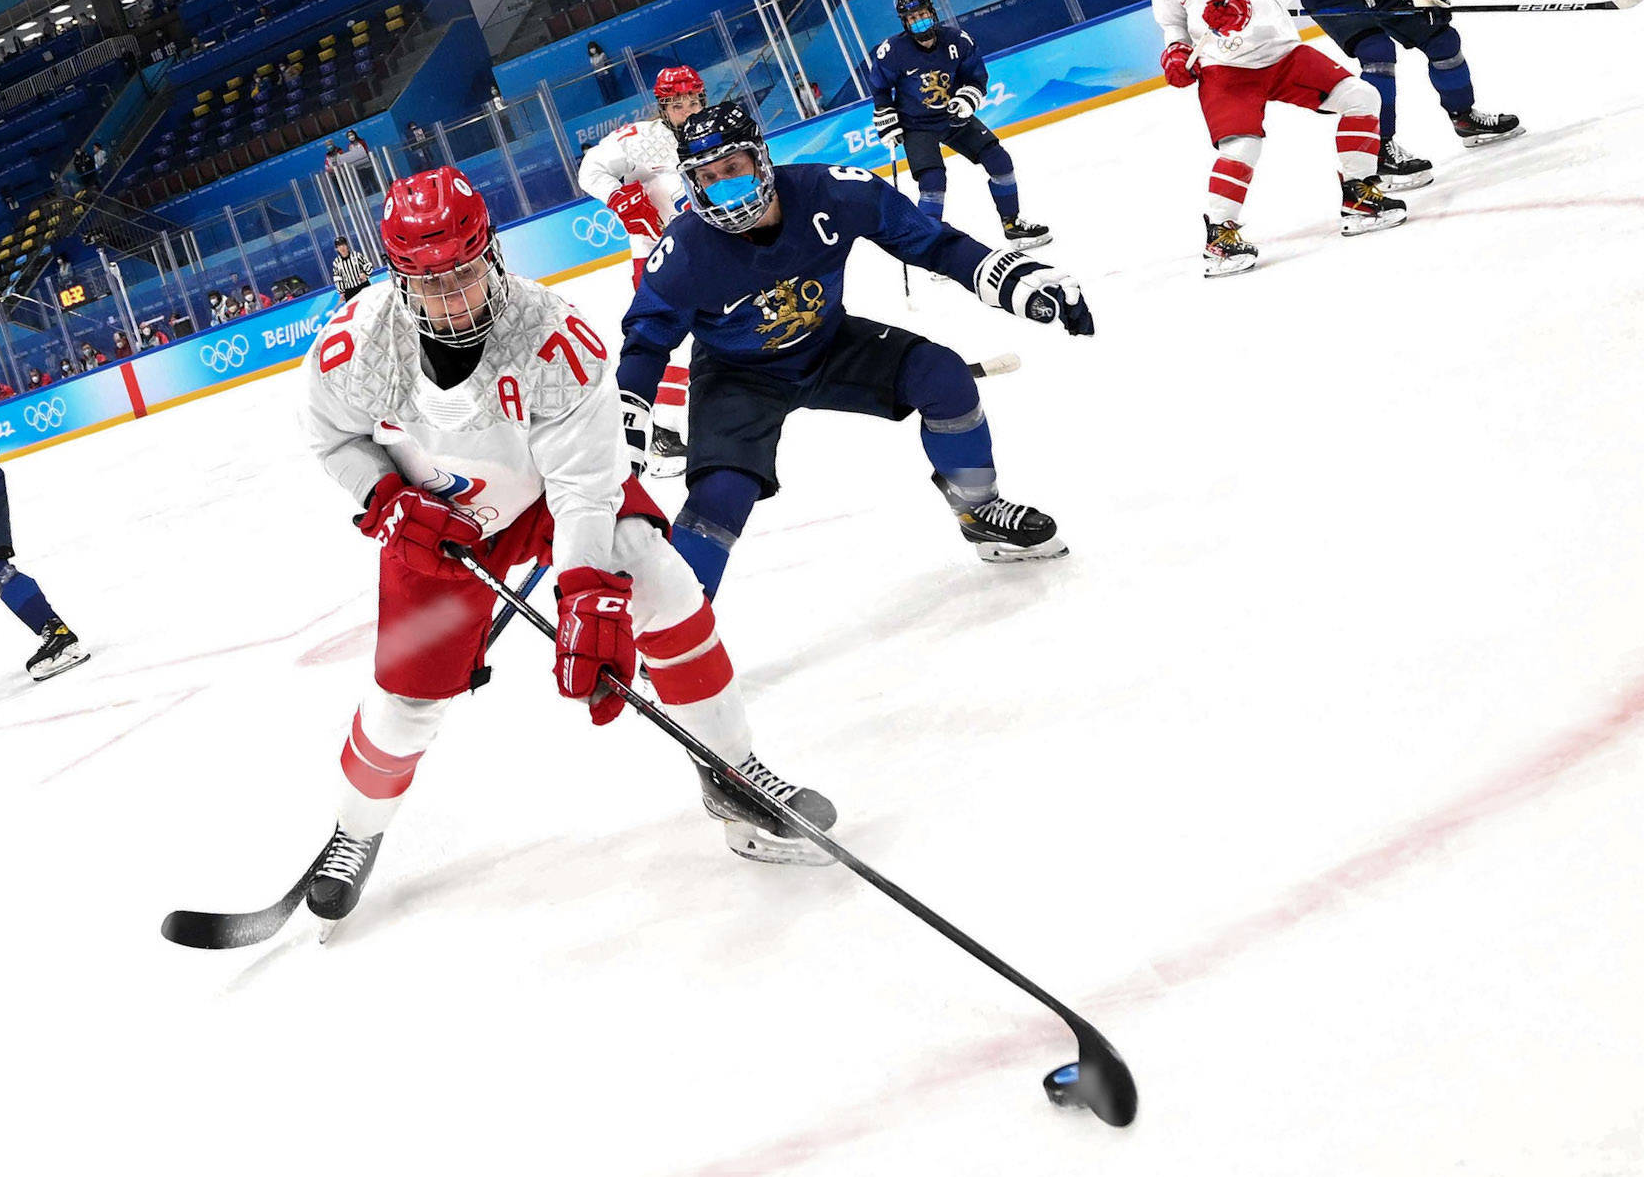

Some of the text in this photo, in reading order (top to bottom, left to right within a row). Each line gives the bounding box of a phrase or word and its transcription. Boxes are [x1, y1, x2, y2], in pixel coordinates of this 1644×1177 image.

[1517, 3, 1587, 12] BAUER
[948, 44, 959, 61] A
[616, 192, 646, 214] CC
[812, 211, 839, 246] C
[646, 235, 675, 280] 6
[261, 314, 325, 349] BEIJING
[537, 315, 608, 386] 70
[497, 375, 524, 422] A
